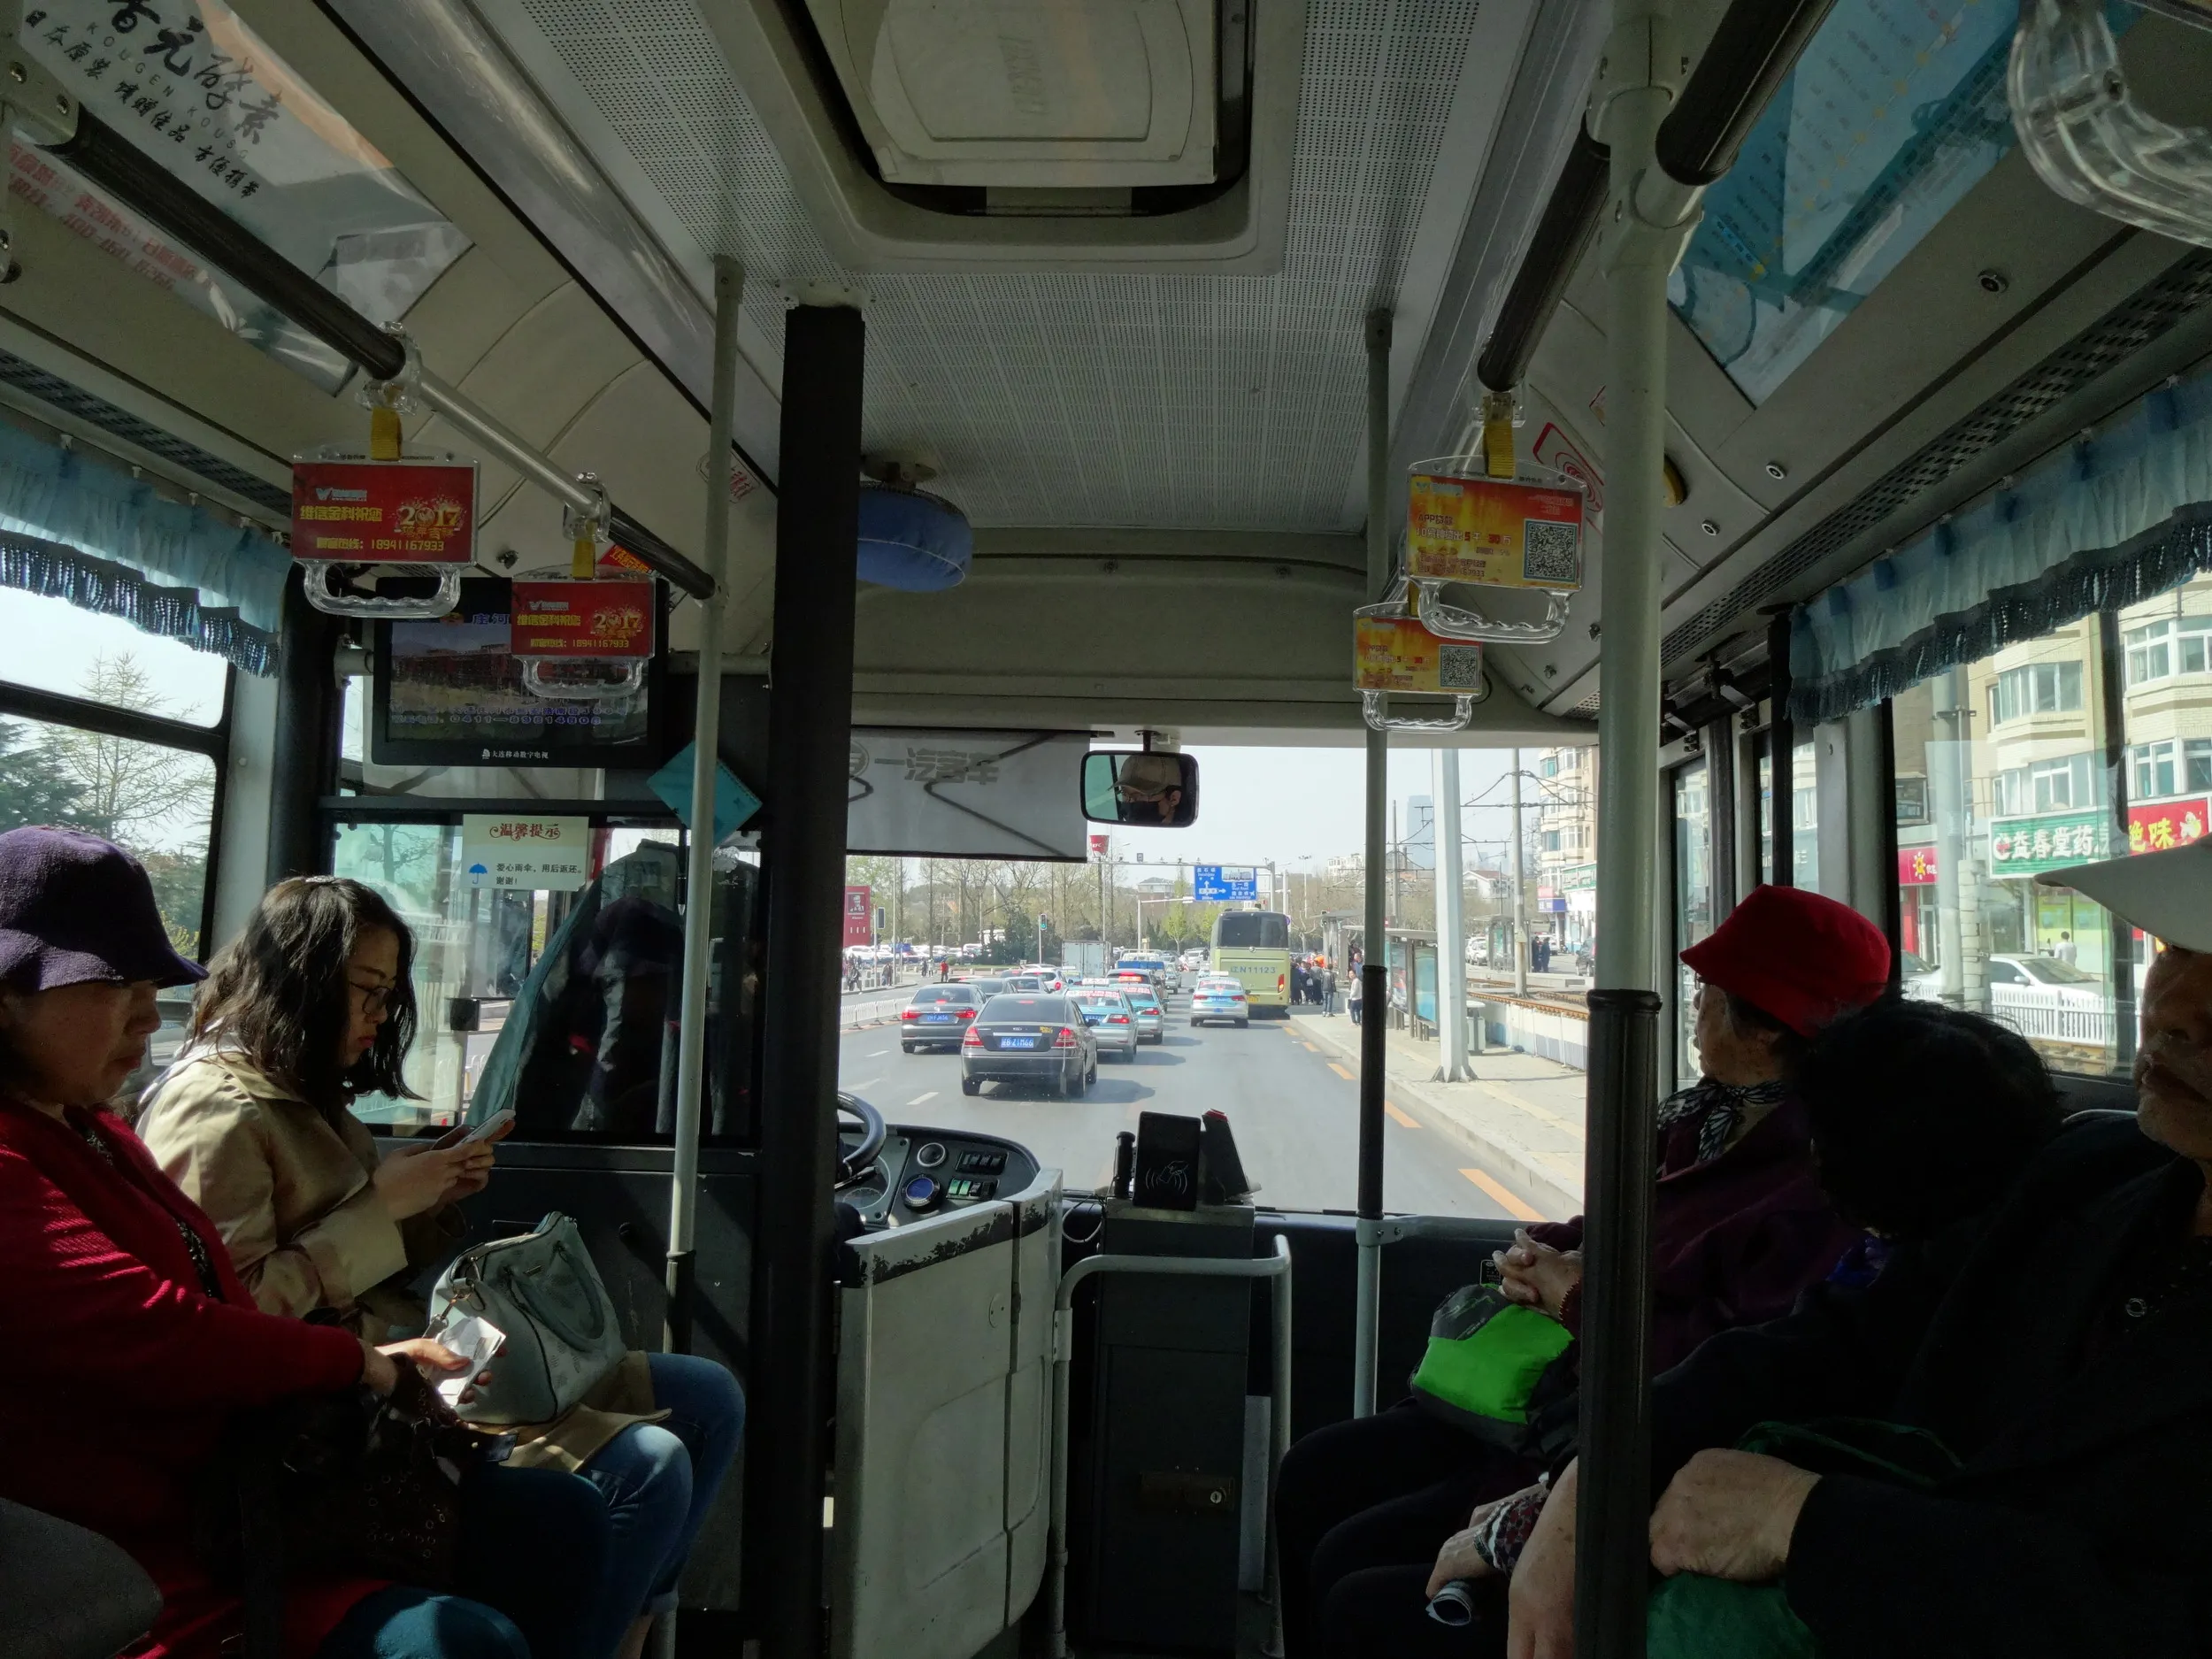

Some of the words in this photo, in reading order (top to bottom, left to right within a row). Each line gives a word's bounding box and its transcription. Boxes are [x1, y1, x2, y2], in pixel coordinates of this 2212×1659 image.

[398, 503, 462, 527] 2017
[491, 823, 561, 840] 温馨提示
